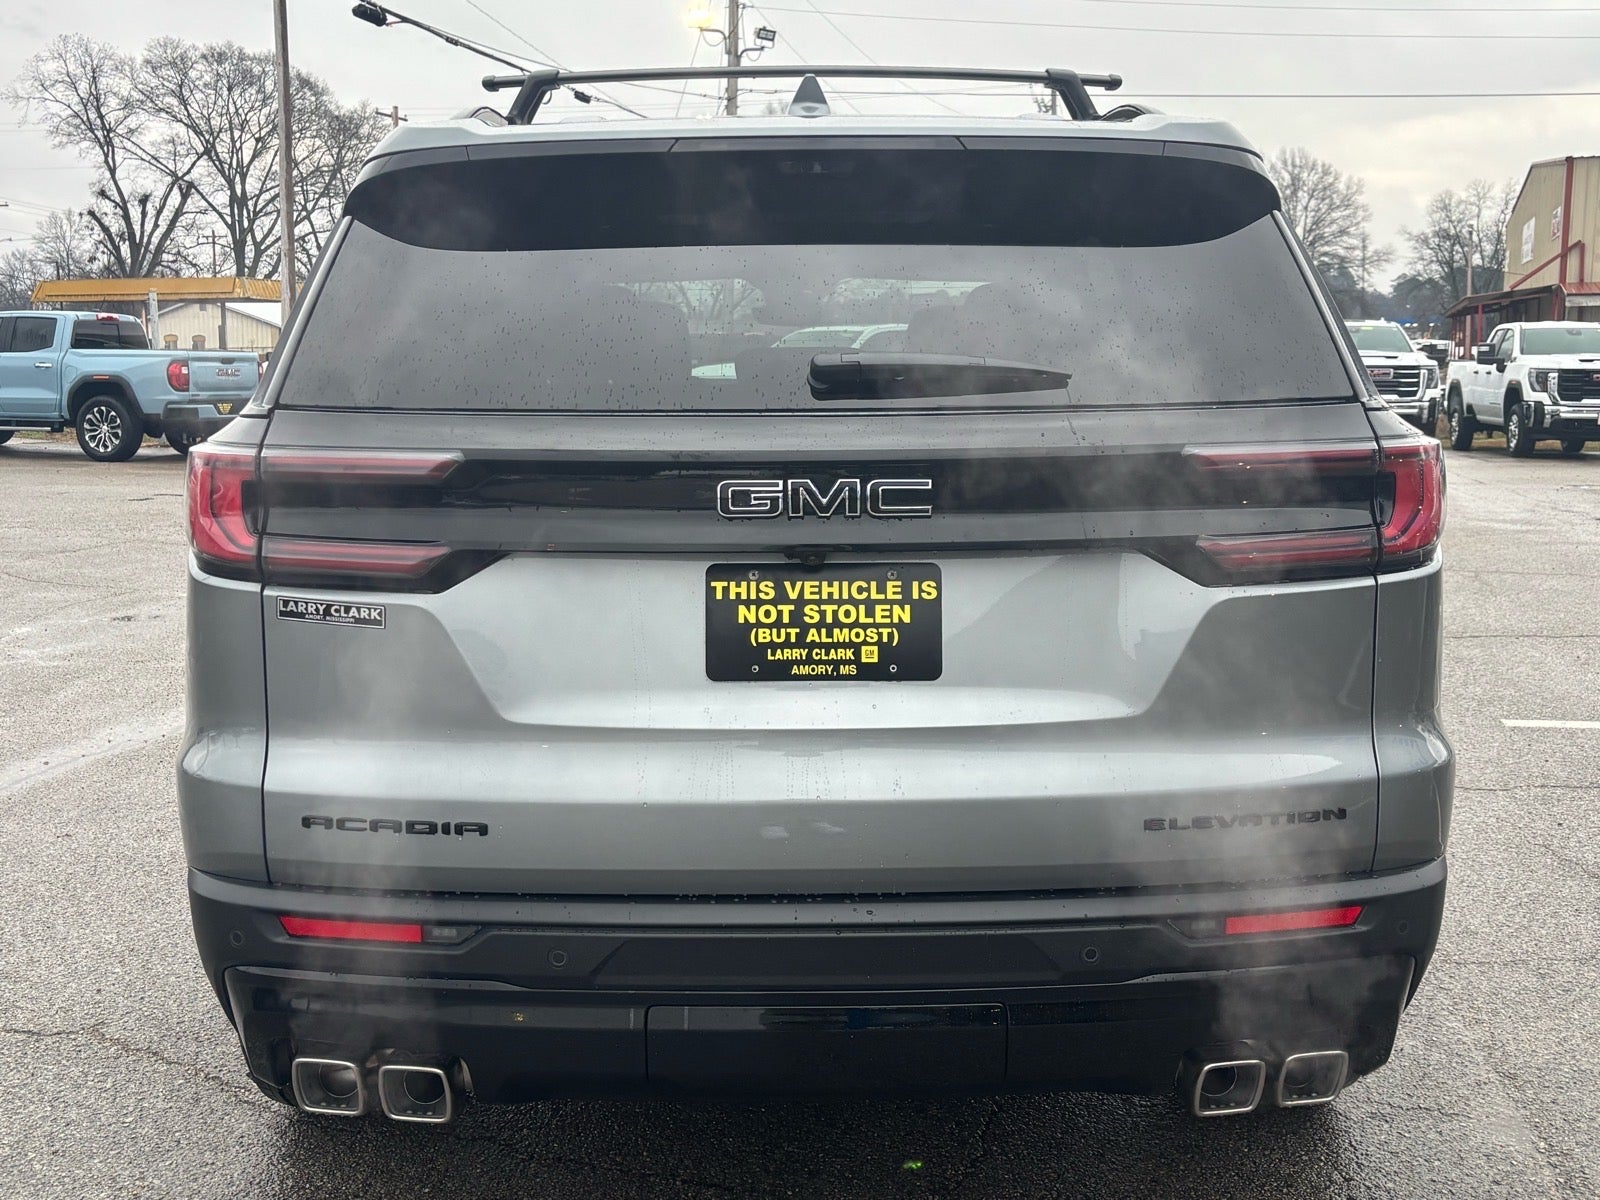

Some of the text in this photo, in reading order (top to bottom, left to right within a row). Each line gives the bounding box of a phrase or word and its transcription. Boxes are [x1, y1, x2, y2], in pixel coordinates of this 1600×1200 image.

[716, 478, 932, 519] GMC
[710, 580, 938, 600] THIS VEHICLE IS
[279, 599, 382, 620] LARRY CLARK
[737, 604, 911, 624] NOT STOLEN
[749, 627, 899, 646] (BUT ALMOST)
[767, 648, 855, 661] LARRY CLARK
[791, 664, 857, 677] AMORY, MS
[301, 814, 488, 836] ACADIA
[1143, 807, 1347, 832] ELEVATION
